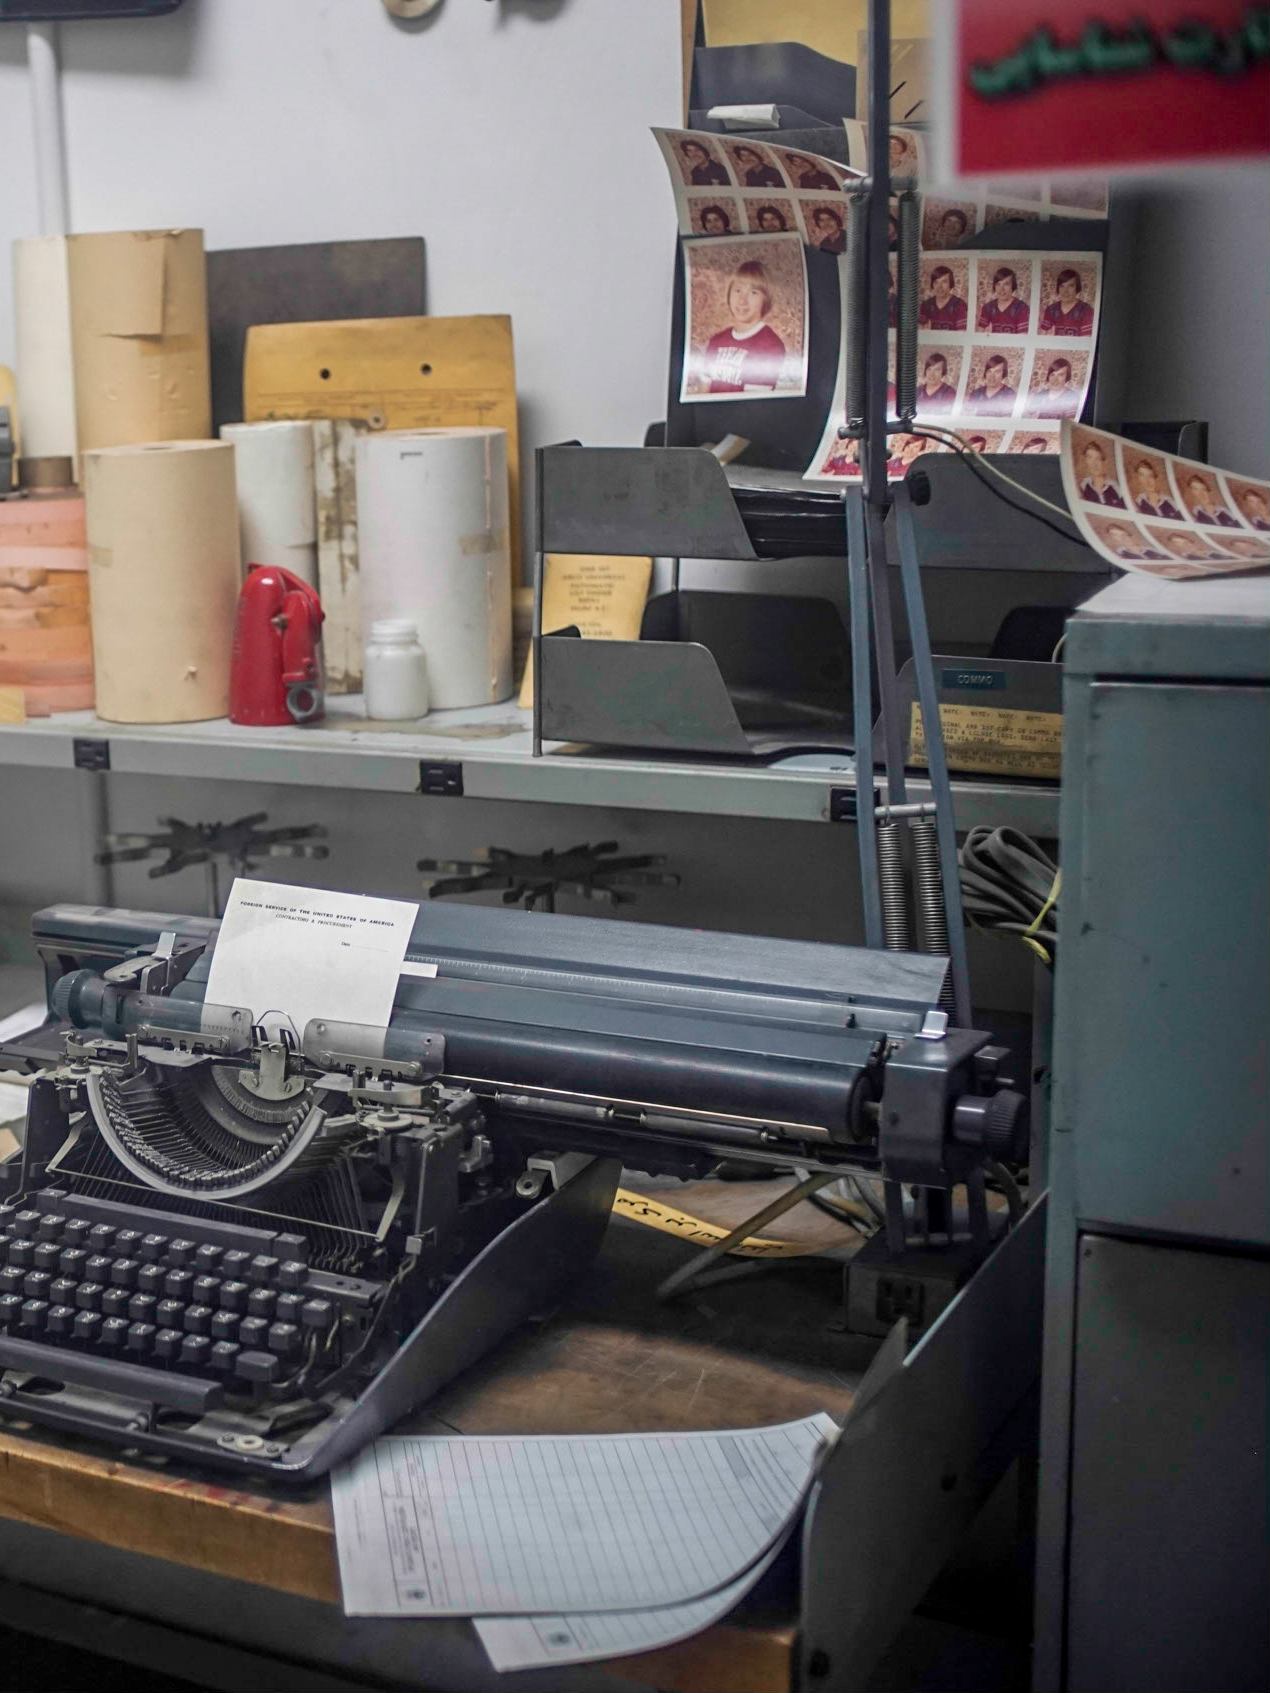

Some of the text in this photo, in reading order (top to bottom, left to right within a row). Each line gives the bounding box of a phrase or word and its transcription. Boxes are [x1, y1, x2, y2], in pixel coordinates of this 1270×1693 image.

[957, 674, 994, 685] COMMO
[265, 904, 287, 912] SERVICE
[369, 919, 395, 927] AMERICA
